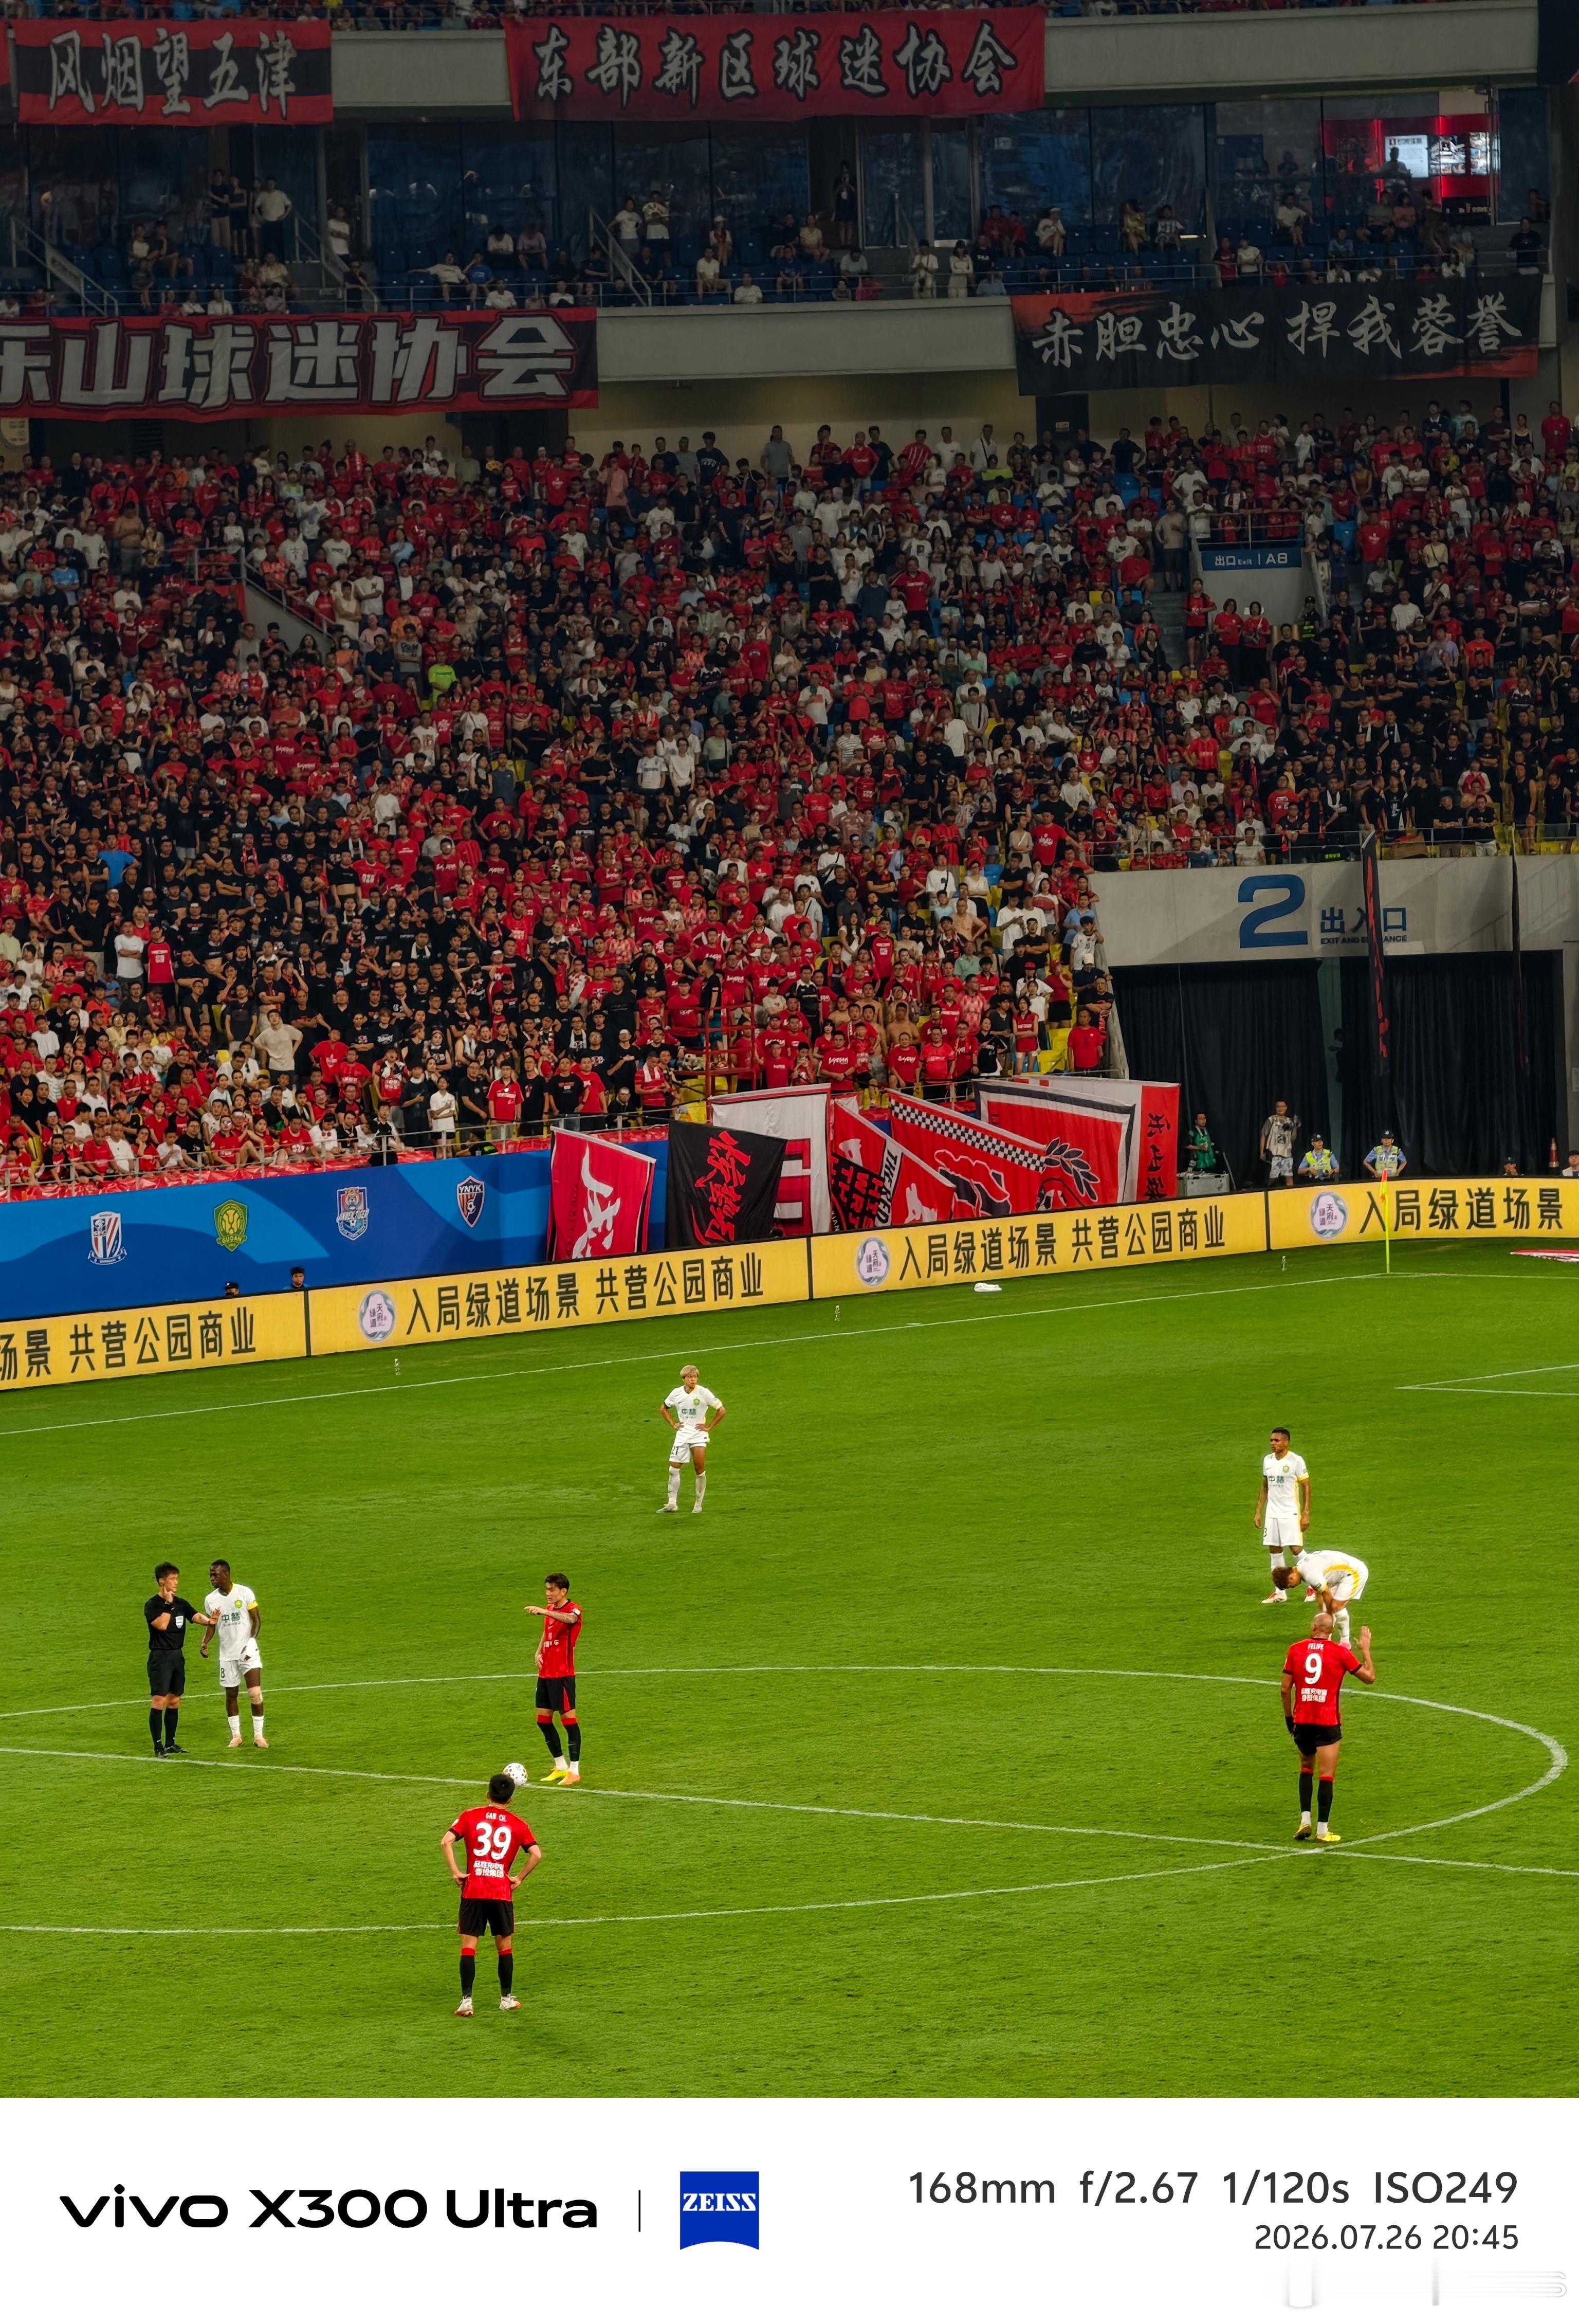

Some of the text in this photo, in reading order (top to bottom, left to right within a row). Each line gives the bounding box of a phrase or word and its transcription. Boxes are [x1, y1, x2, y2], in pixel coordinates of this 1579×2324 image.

[48, 27, 298, 120] 风烟望五津
[534, 20, 1017, 108] 东部新区球迷协会
[1033, 292, 1522, 368] 赤胆忠心 捍我蓉誉
[1215, 555, 1236, 566] 出口
[1238, 874, 1308, 948] 2
[459, 1184, 481, 1193] YNYK
[884, 1149, 898, 1187] THE
[1360, 1187, 1563, 1234] 入局绿道场景
[899, 1205, 1225, 1281] 入局绿道场景 共营公园商业
[406, 1252, 763, 1335] 入局绿道场景 共营公园商业
[69, 1306, 256, 1373] 共营公园商业
[221, 1667, 225, 1678] 8
[1305, 1653, 1322, 1684] 9
[473, 1822, 511, 1860] 39
